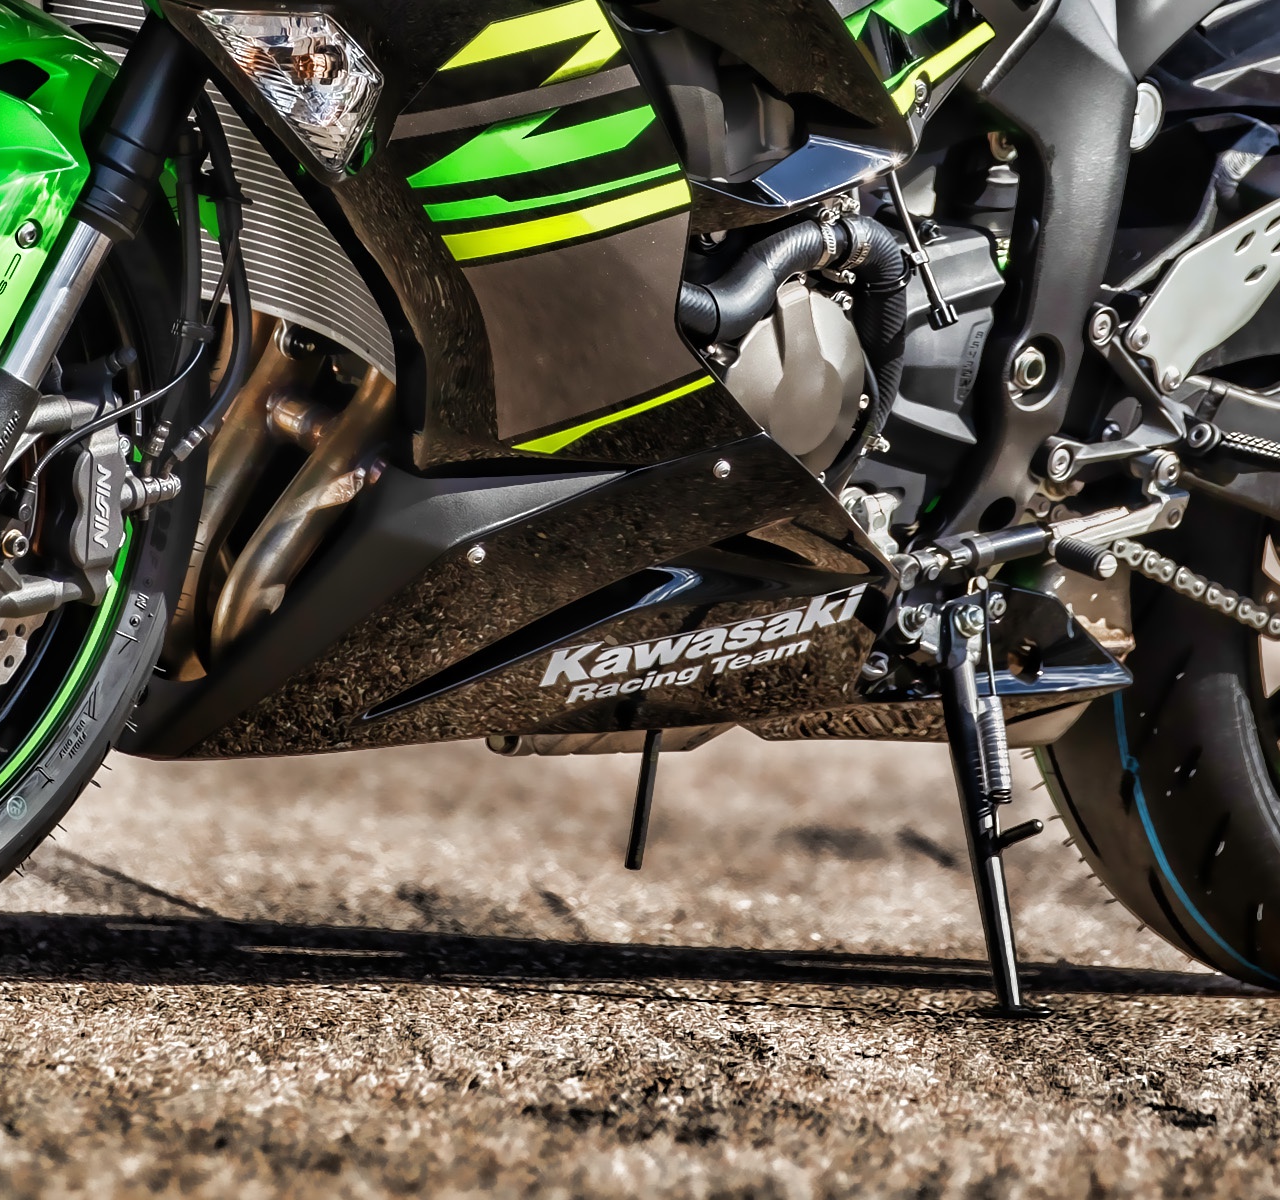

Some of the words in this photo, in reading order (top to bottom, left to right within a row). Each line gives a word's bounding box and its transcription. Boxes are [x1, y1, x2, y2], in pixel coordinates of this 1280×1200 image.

[93, 463, 112, 549] NISSIN
[538, 582, 869, 688] Kawasaki
[565, 664, 704, 704] Racing
[710, 639, 811, 676] Team
